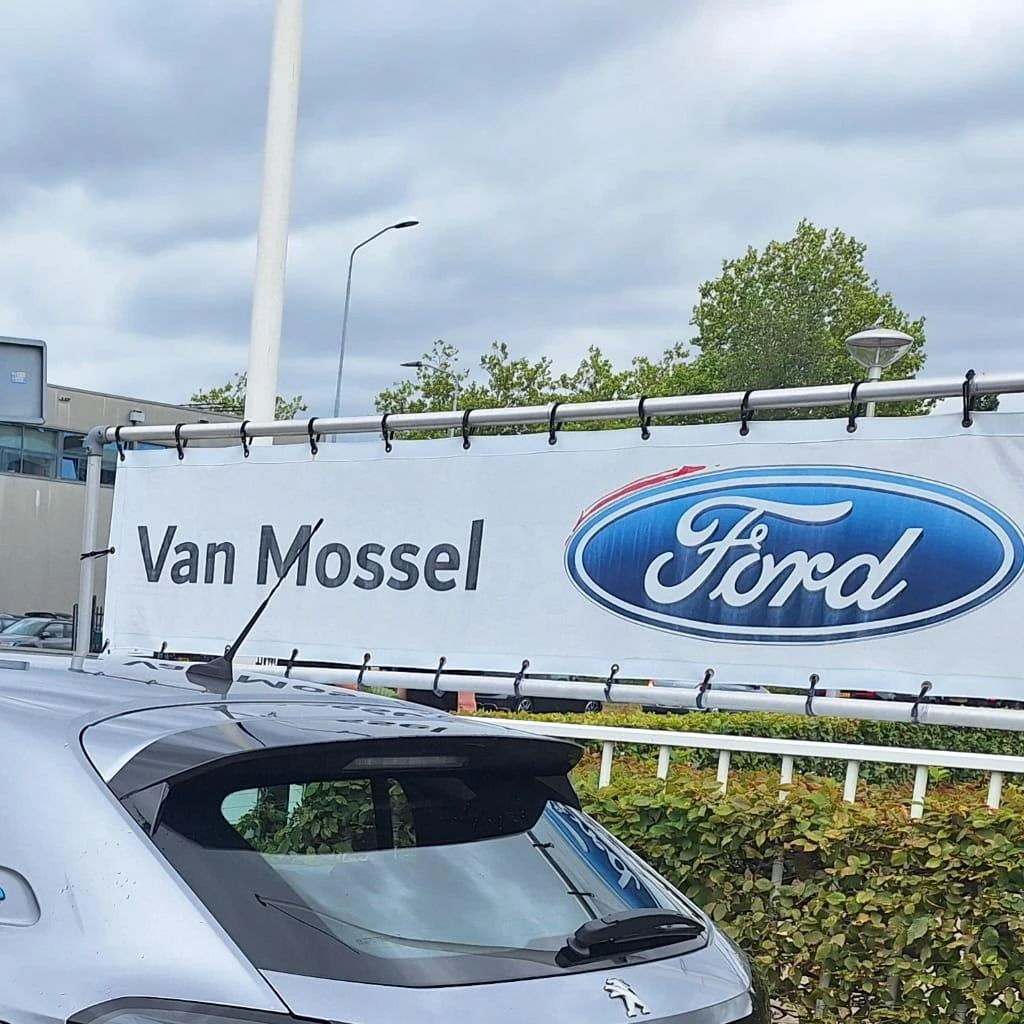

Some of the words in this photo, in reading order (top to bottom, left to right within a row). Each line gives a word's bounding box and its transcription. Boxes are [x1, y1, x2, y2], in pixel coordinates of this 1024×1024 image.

[137, 525, 236, 585] Van
[256, 518, 485, 592] Mossel
[643, 495, 925, 612] Ford
